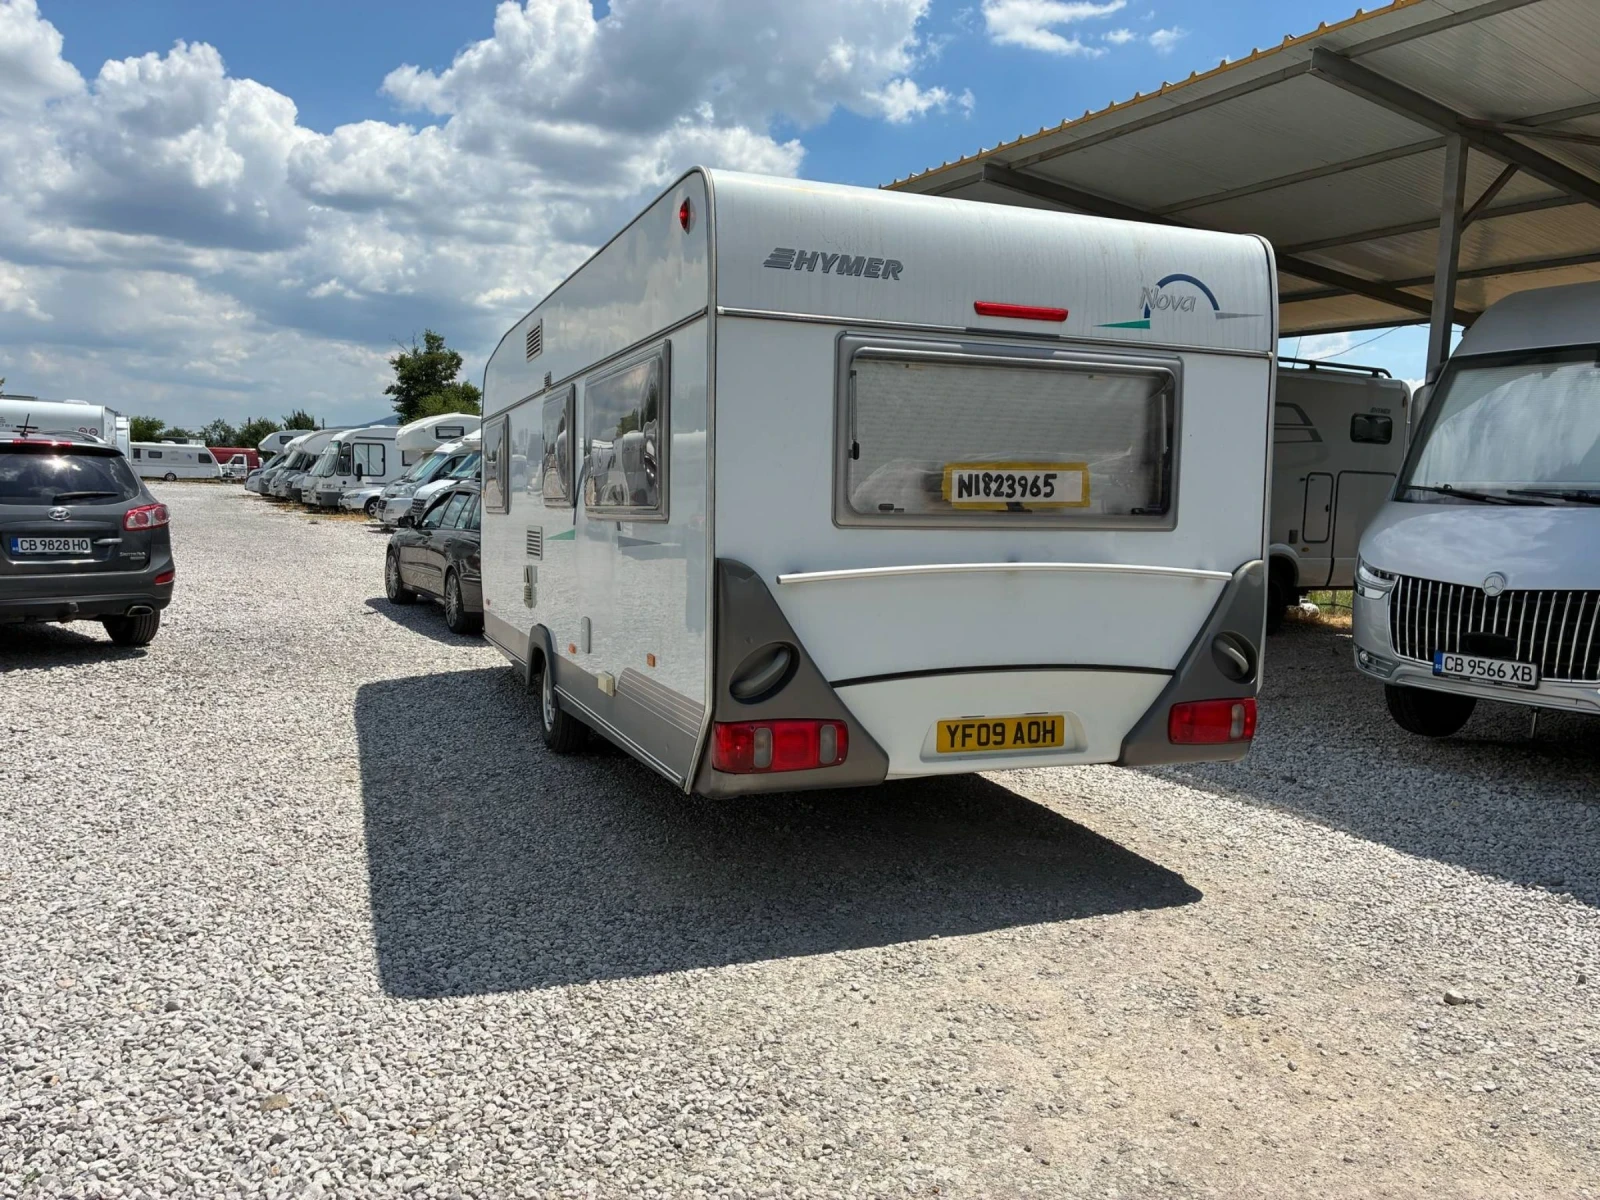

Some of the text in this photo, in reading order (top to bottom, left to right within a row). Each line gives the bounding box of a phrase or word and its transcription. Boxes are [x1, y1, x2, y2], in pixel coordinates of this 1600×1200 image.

[793, 249, 905, 281] HYMER
[1139, 286, 1197, 313] Nova
[20, 539, 38, 552] CB
[40, 539, 71, 551] 9828
[1444, 656, 1465, 673] CB
[1467, 659, 1507, 679] 9566
[1509, 664, 1533, 682] XB
[946, 719, 1056, 748] YF09 AOH
